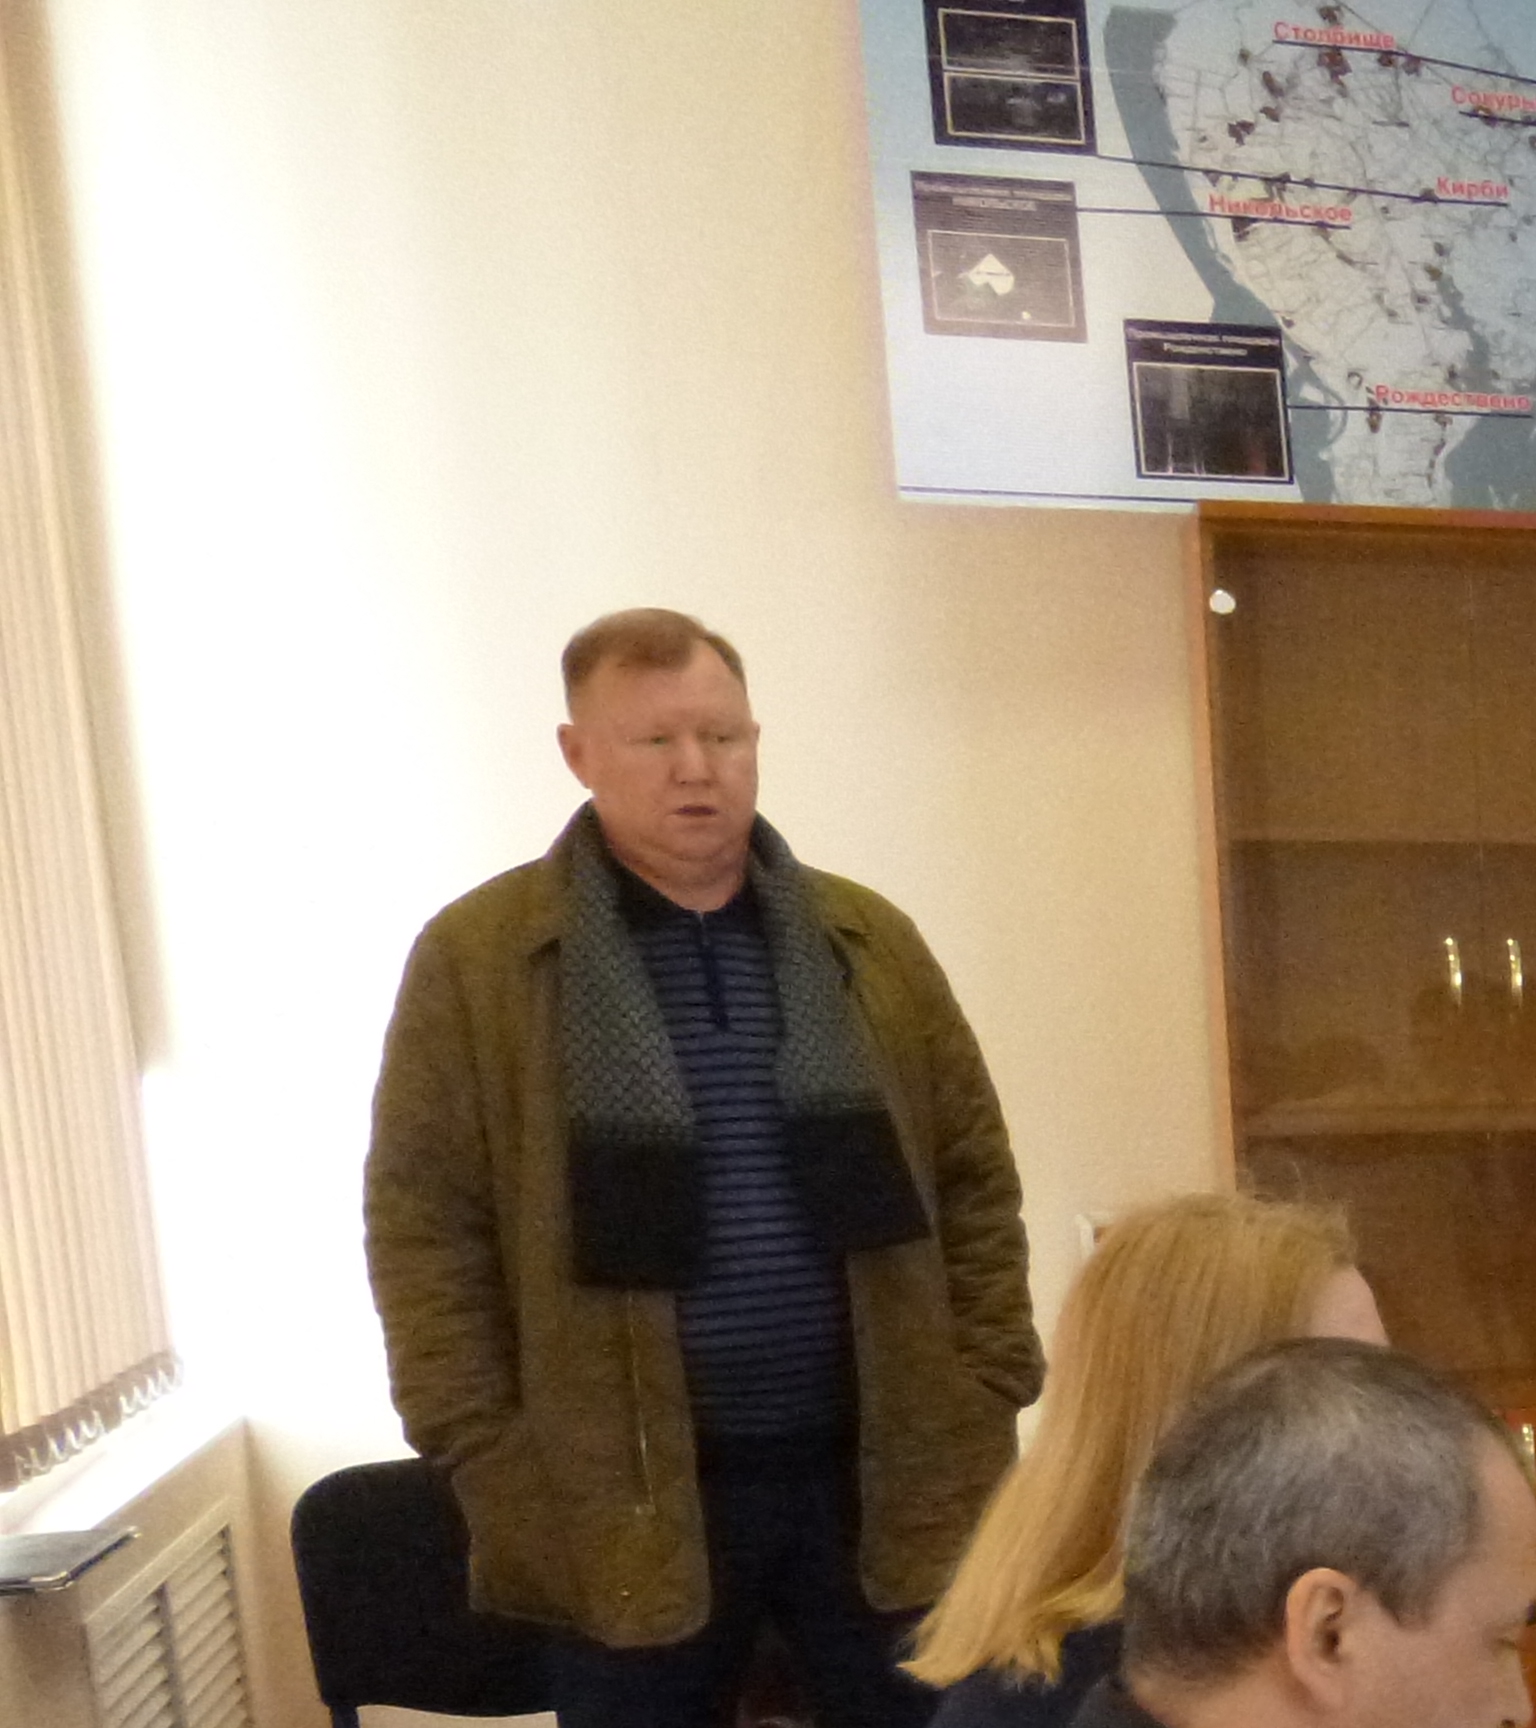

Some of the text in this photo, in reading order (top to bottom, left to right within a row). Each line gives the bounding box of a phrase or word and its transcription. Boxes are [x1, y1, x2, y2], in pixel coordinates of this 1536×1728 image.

[1273, 21, 1395, 48] Столбище
[1437, 176, 1510, 199] Кирби
[1209, 194, 1353, 222] Никольское
